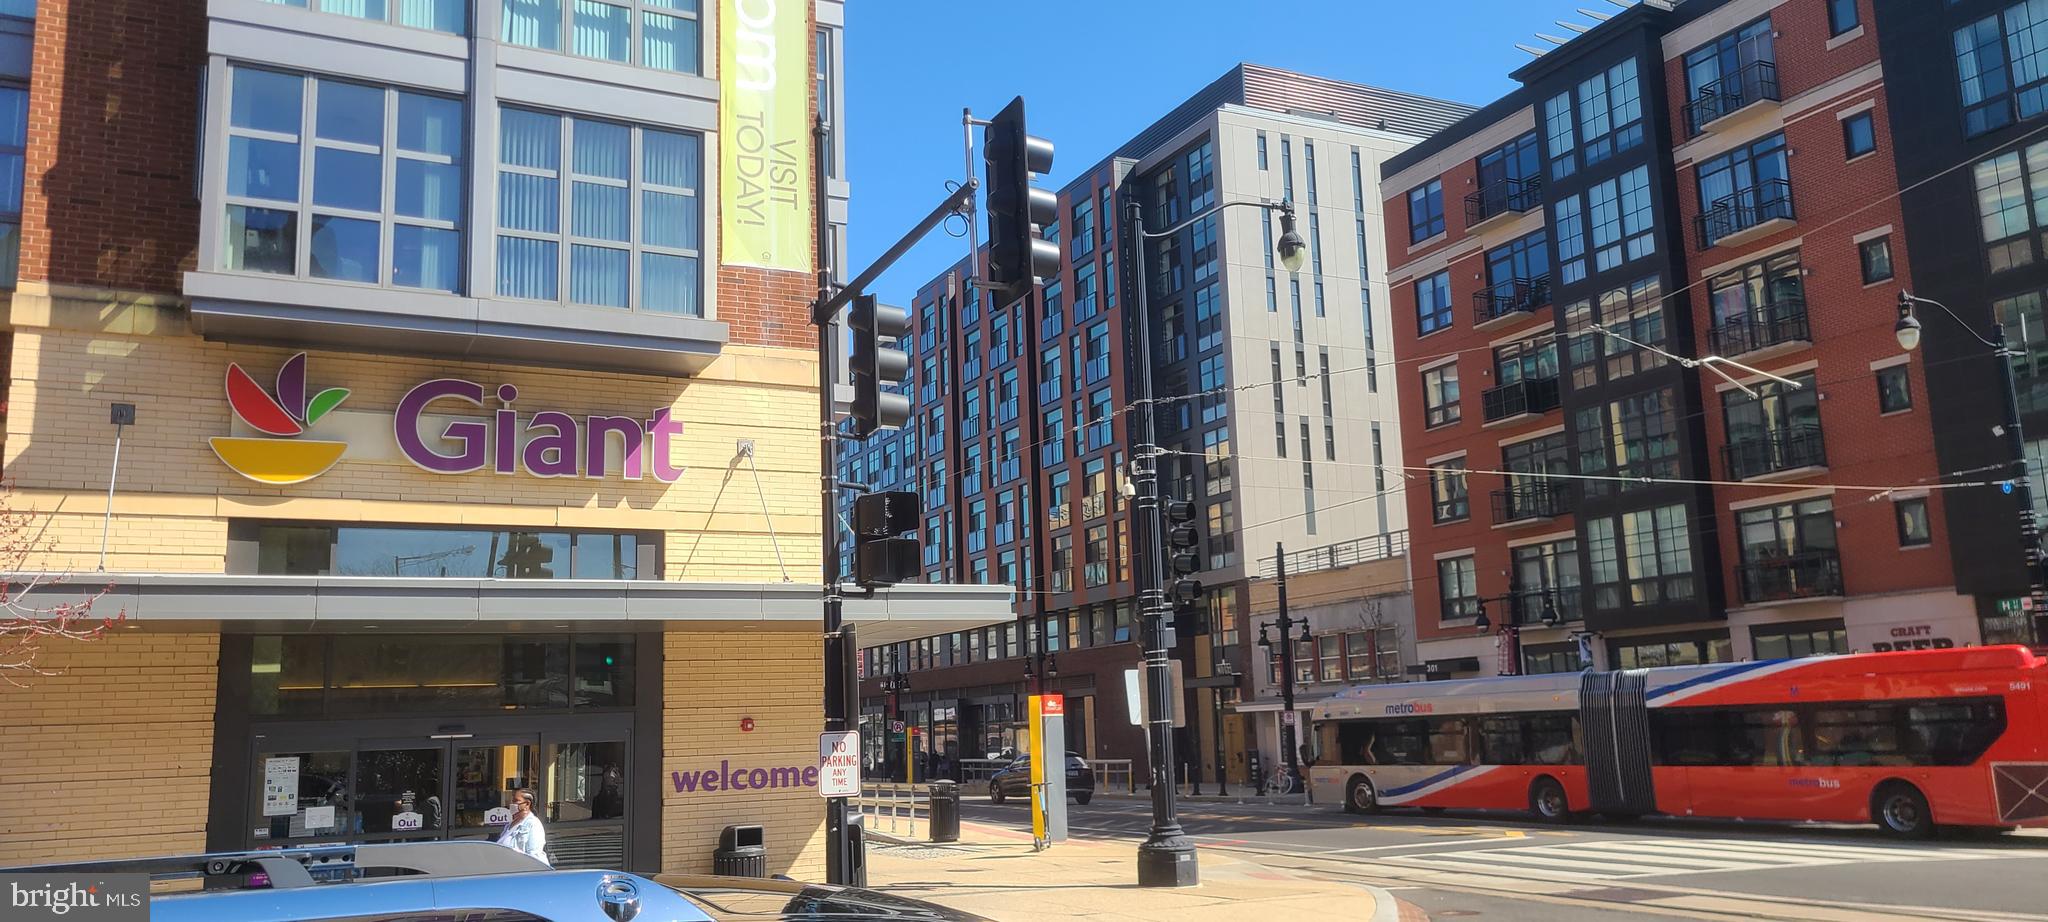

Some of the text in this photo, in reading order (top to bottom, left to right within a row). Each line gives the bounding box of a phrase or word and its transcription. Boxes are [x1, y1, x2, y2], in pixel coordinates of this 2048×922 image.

[736, 111, 765, 226] TODAY!
[769, 139, 798, 210] VISIT
[394, 378, 687, 483] Giant
[1890, 625, 1931, 637] CRAFT
[1426, 664, 1438, 673] 301
[1385, 703, 1433, 714] metrobus
[831, 741, 847, 753] NO
[821, 755, 857, 767] PARKING
[671, 759, 820, 793] welcome
[832, 768, 847, 776] ANY
[832, 777, 848, 786] TIME
[398, 818, 417, 827] Out
[489, 813, 508, 823] Out
